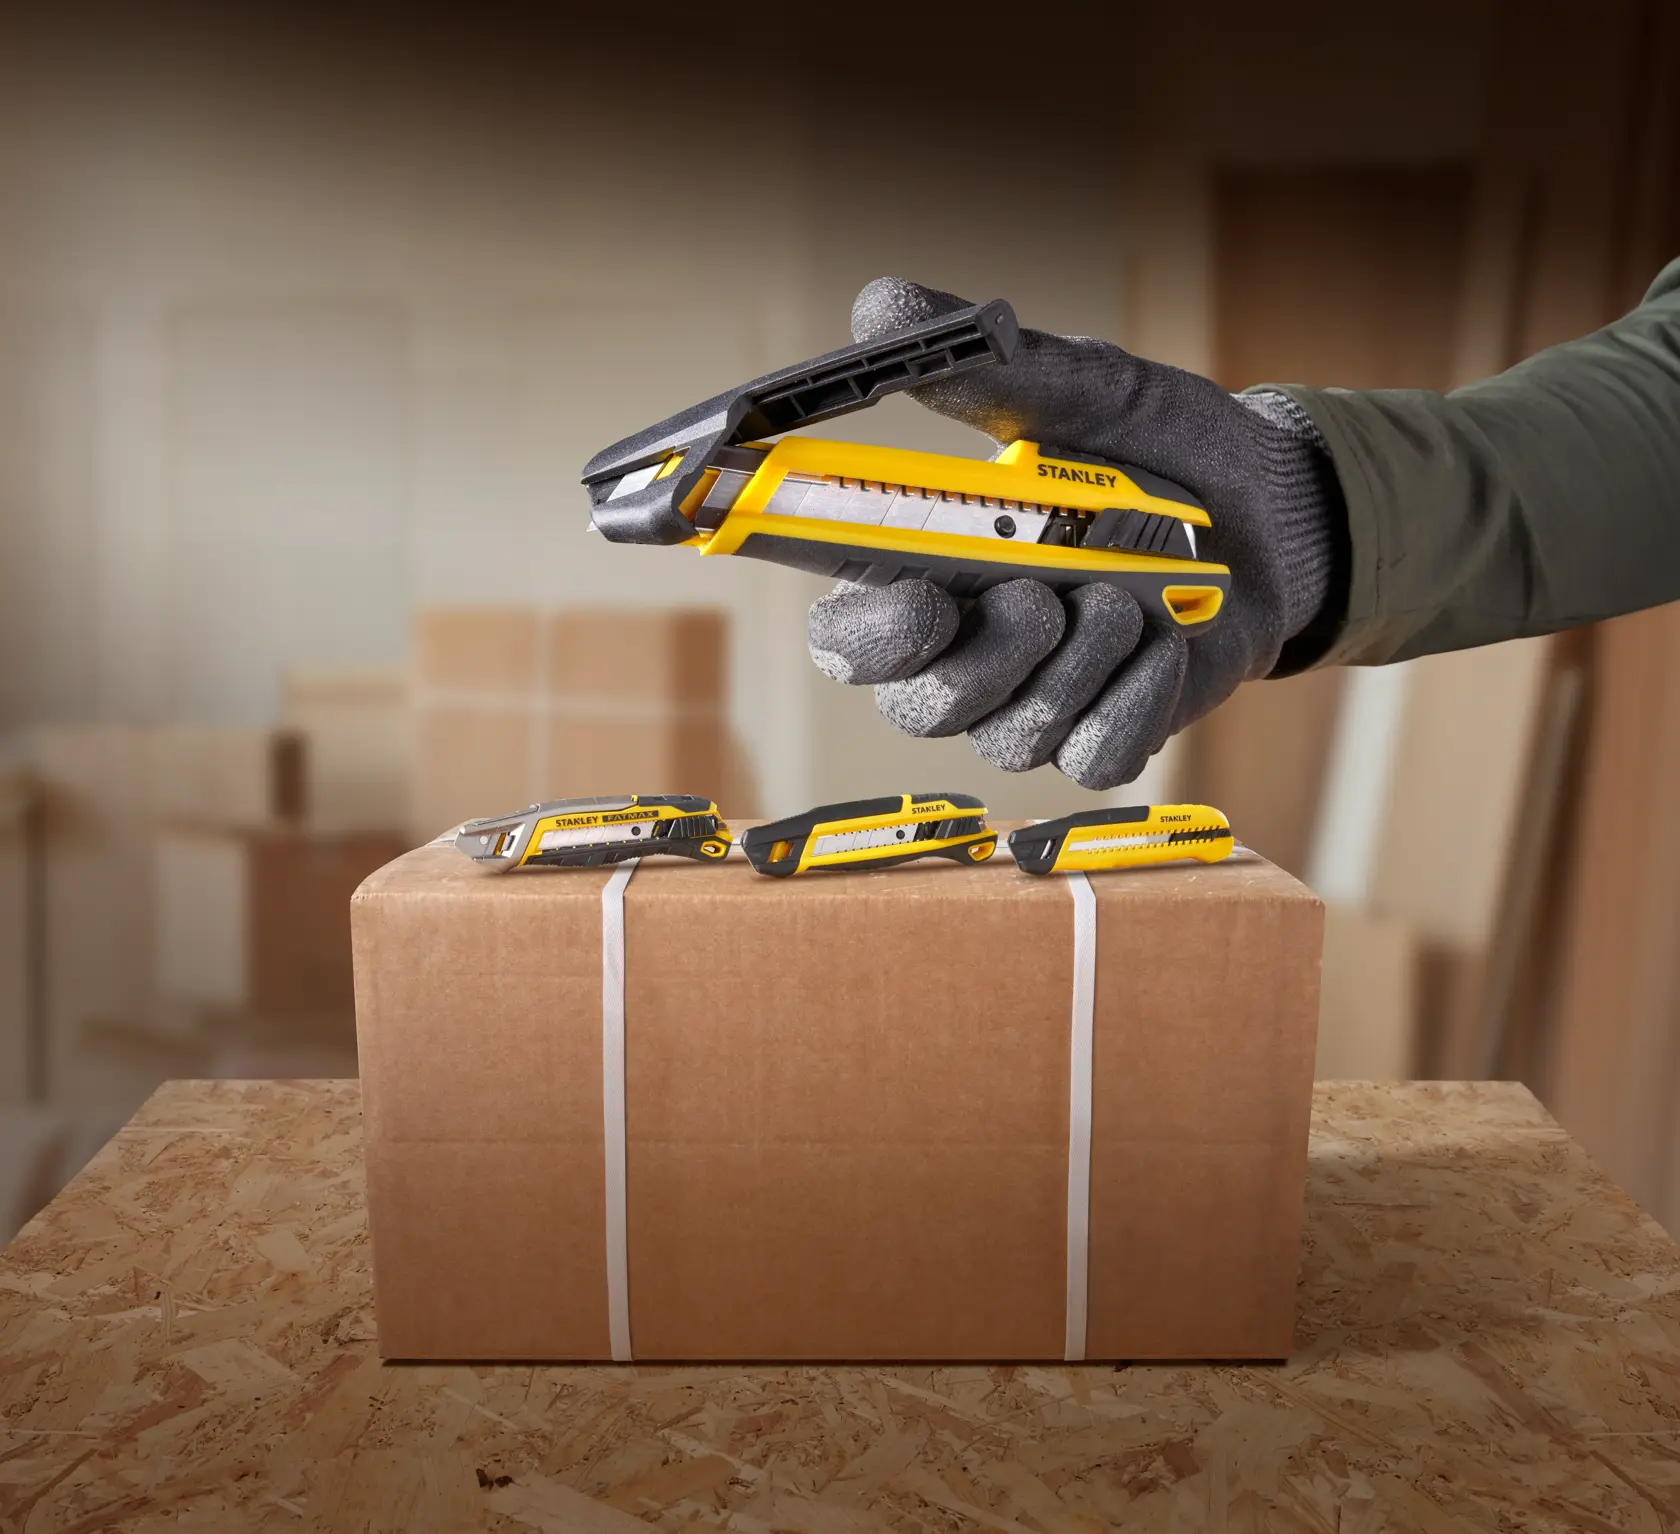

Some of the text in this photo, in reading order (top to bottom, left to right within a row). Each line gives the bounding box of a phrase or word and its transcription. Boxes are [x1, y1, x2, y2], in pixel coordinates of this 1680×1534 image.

[1037, 463, 1117, 488] STANLEY
[911, 803, 946, 814] STANLEY
[555, 811, 654, 828] STANLEY FATMAX
[1160, 814, 1192, 823] STANLEY
